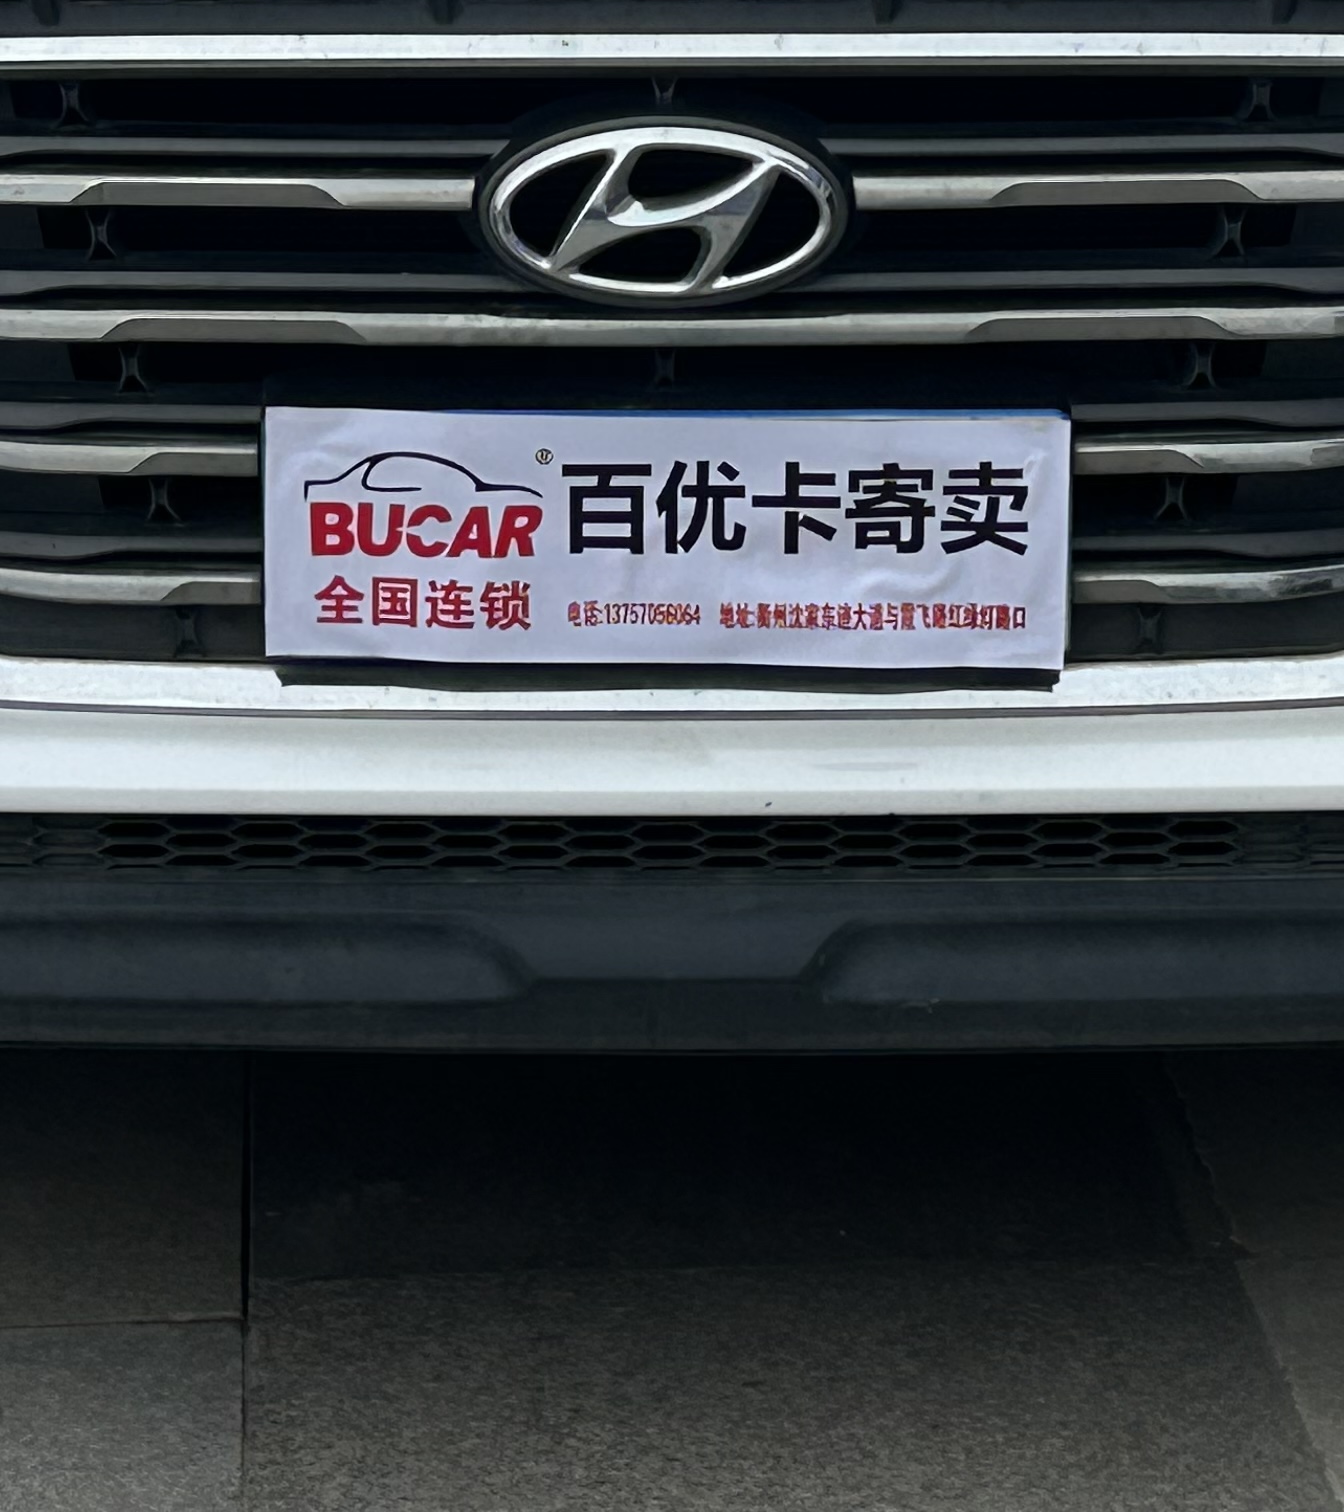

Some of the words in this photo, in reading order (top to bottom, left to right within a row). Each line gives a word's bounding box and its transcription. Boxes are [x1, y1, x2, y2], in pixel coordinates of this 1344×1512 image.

[309, 501, 544, 559] BUCAR
[561, 460, 1029, 556] 百优卡寄卖
[313, 574, 532, 631] 全国连锁
